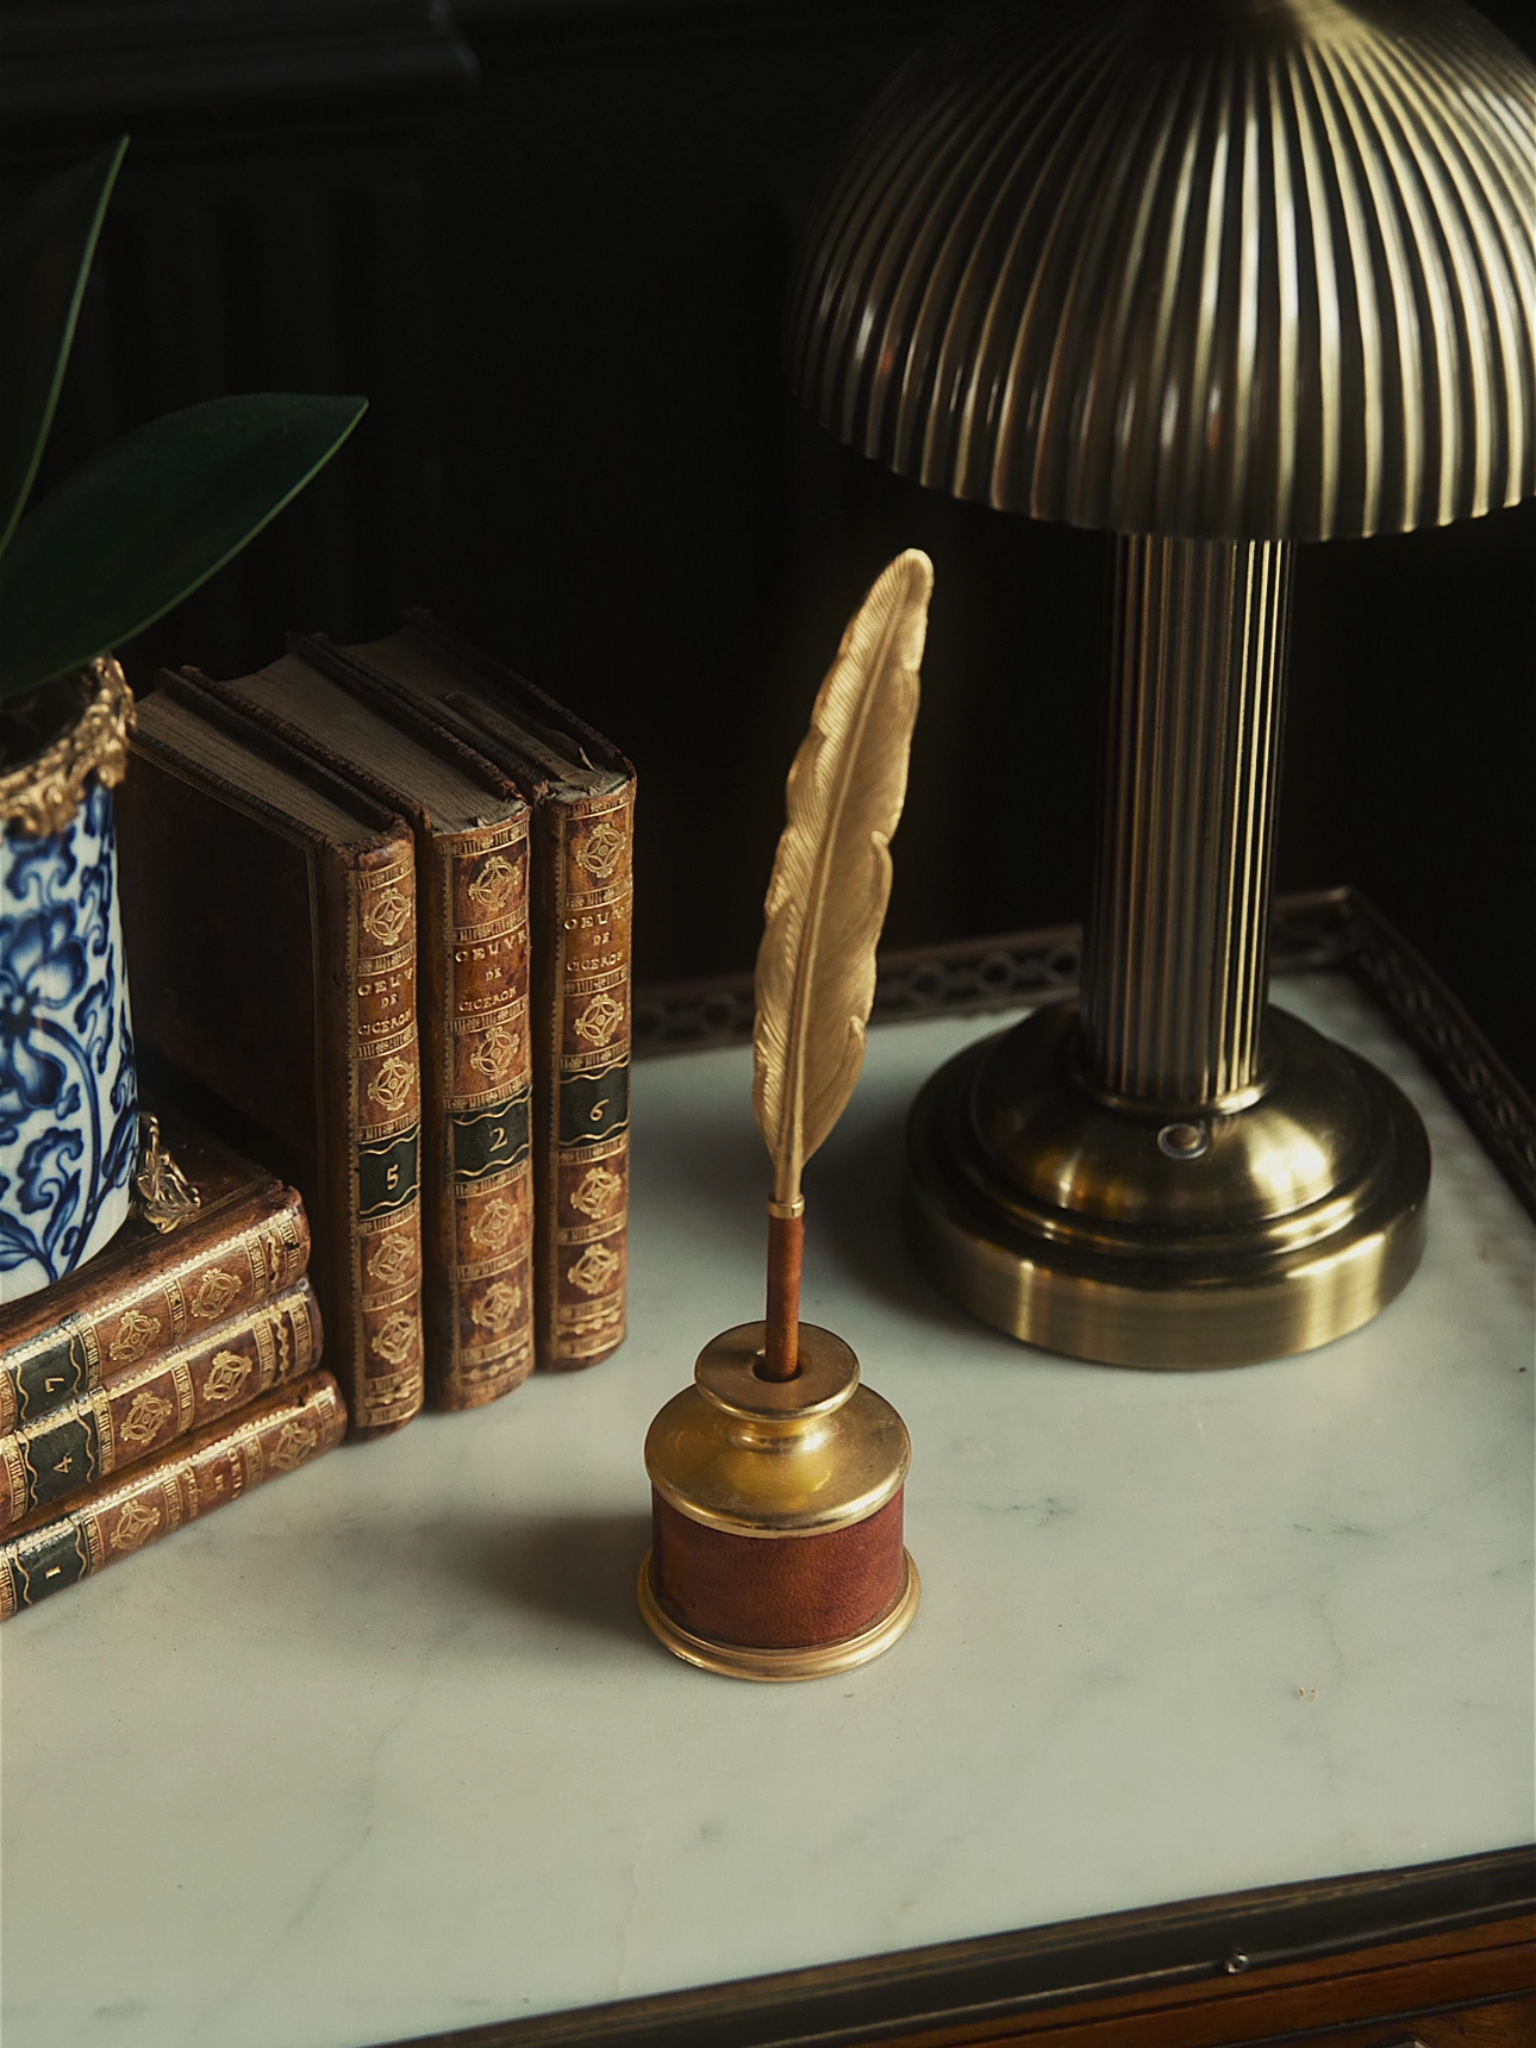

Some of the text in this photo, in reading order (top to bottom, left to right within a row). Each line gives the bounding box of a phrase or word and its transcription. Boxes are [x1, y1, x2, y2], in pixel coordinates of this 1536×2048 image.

[593, 932, 610, 946] DE
[486, 967, 502, 982] DE
[381, 993, 398, 1009] DE
[459, 986, 517, 1011] CICERON
[357, 1008, 412, 1035] CICERON
[589, 1099, 609, 1122] 6
[489, 1127, 508, 1152] 2
[386, 1164, 399, 1190] 5
[45, 1377, 65, 1393] 7
[53, 1455, 73, 1473] 4
